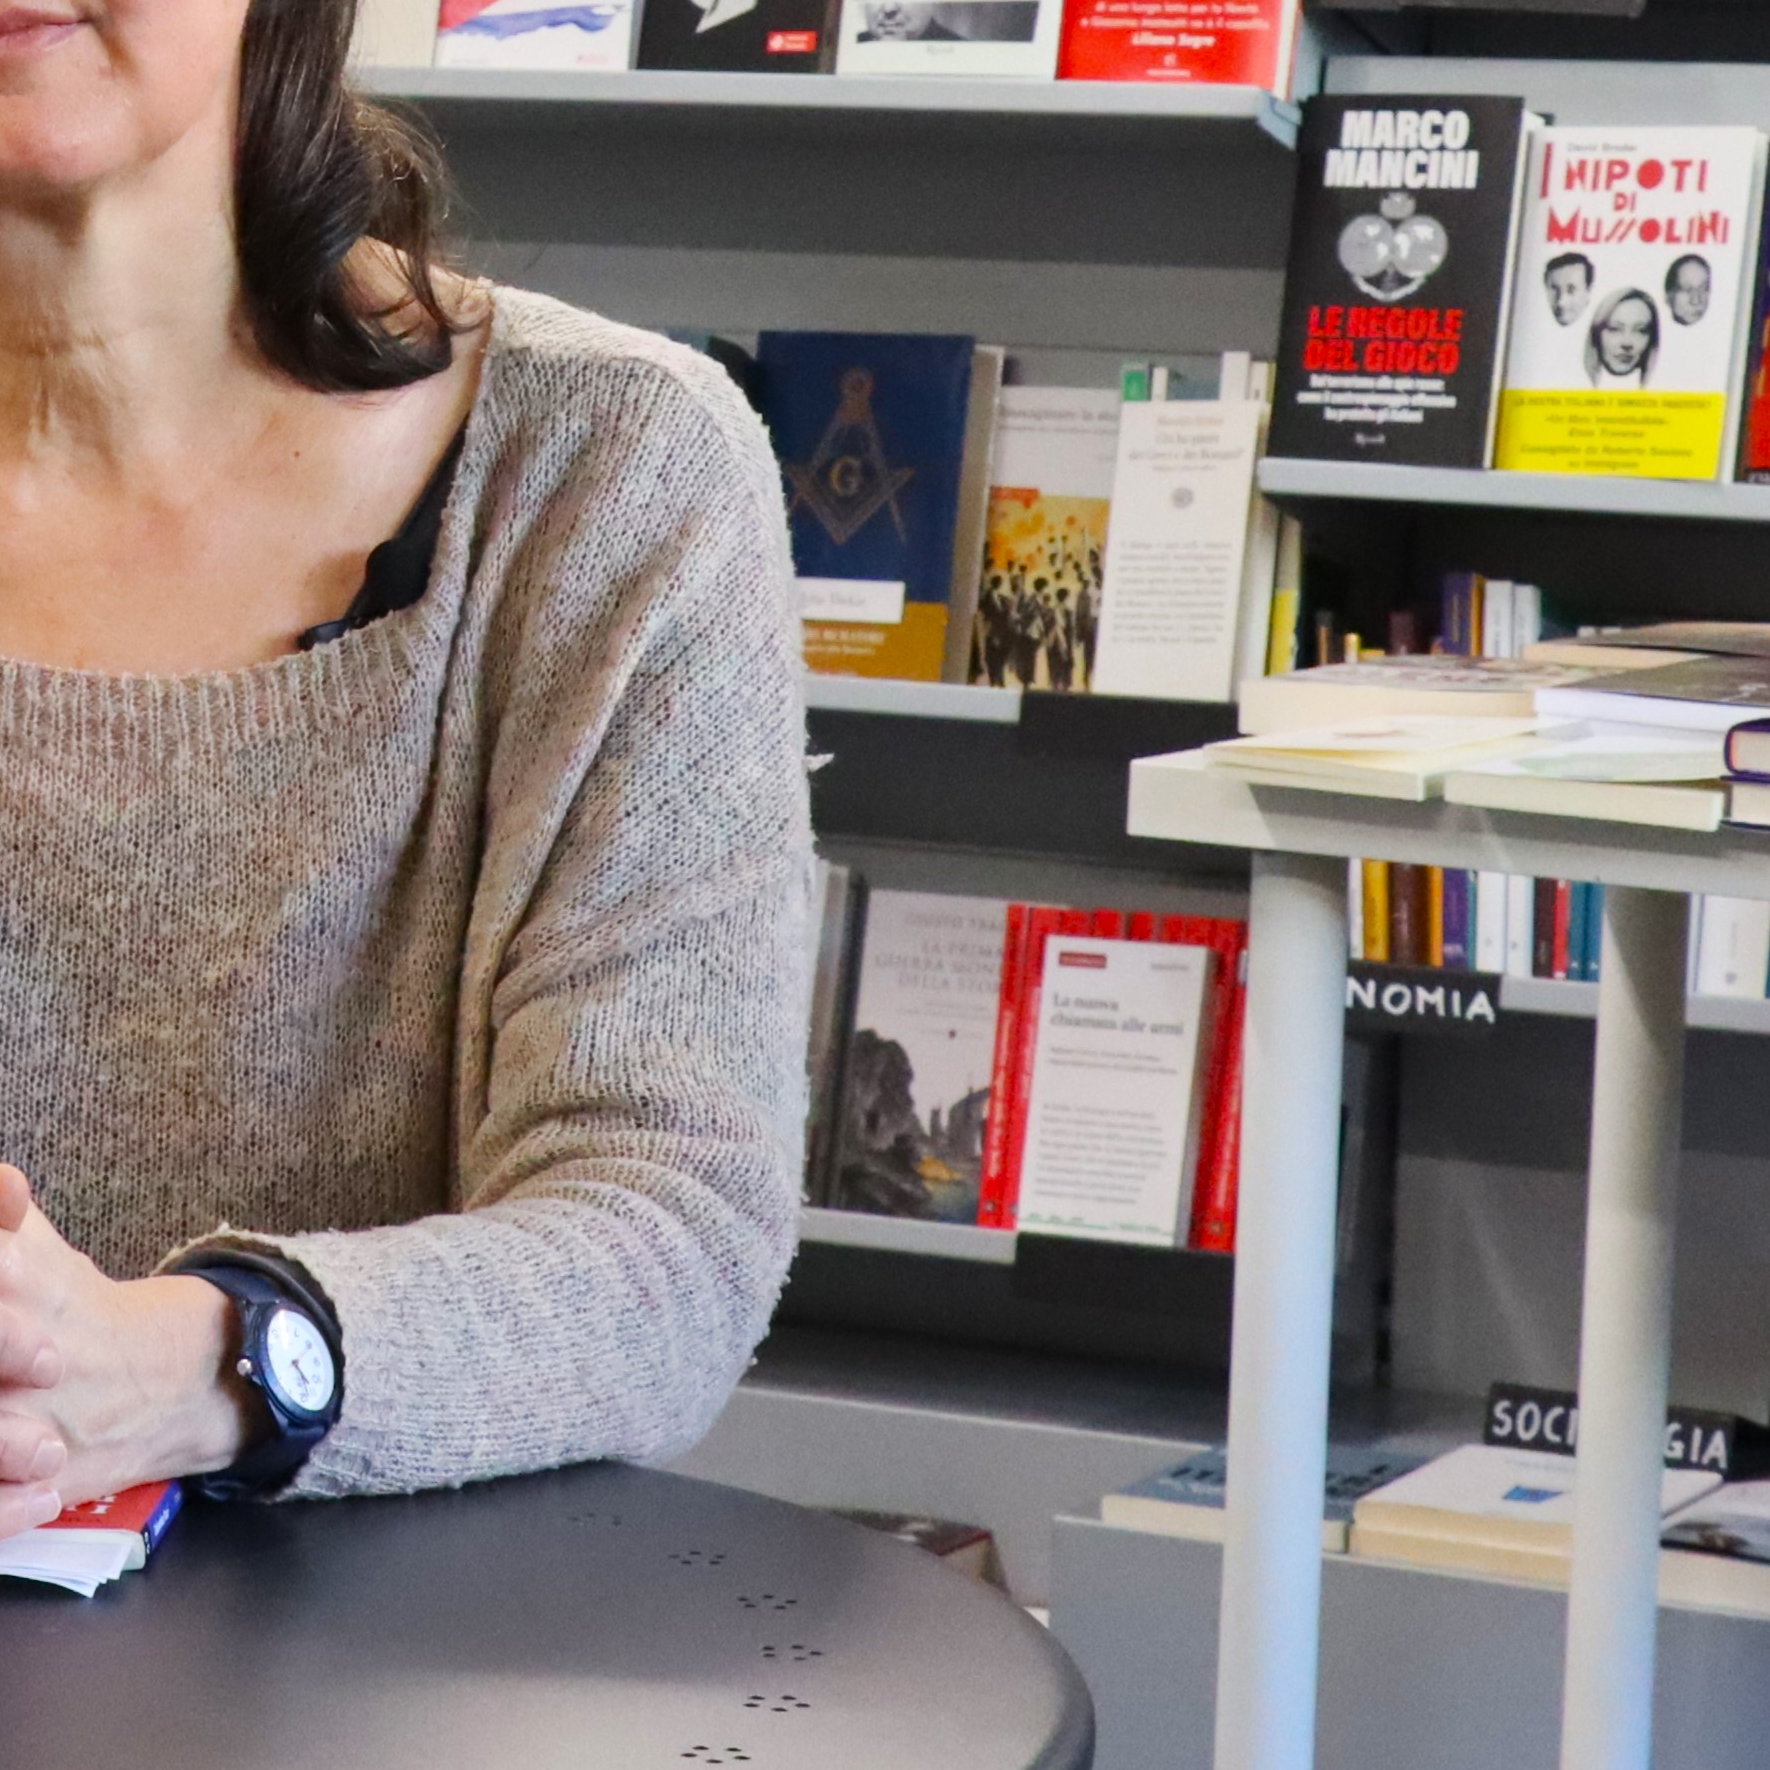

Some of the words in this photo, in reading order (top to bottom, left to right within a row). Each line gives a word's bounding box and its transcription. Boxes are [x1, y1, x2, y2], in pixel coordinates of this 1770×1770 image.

[1340, 109, 1470, 149] MARCO
[1323, 149, 1480, 190] MANCINI
[1564, 159, 1710, 193] NIPOTI
[1613, 192, 1637, 212] DI
[1307, 305, 1345, 338] LE
[1346, 306, 1466, 342] REGOLE
[1302, 338, 1359, 371] DEL
[1362, 339, 1461, 375] GIOCO
[1345, 977, 1497, 1026] NOMIA
[1491, 1400, 1729, 1469] SOCIGIA
